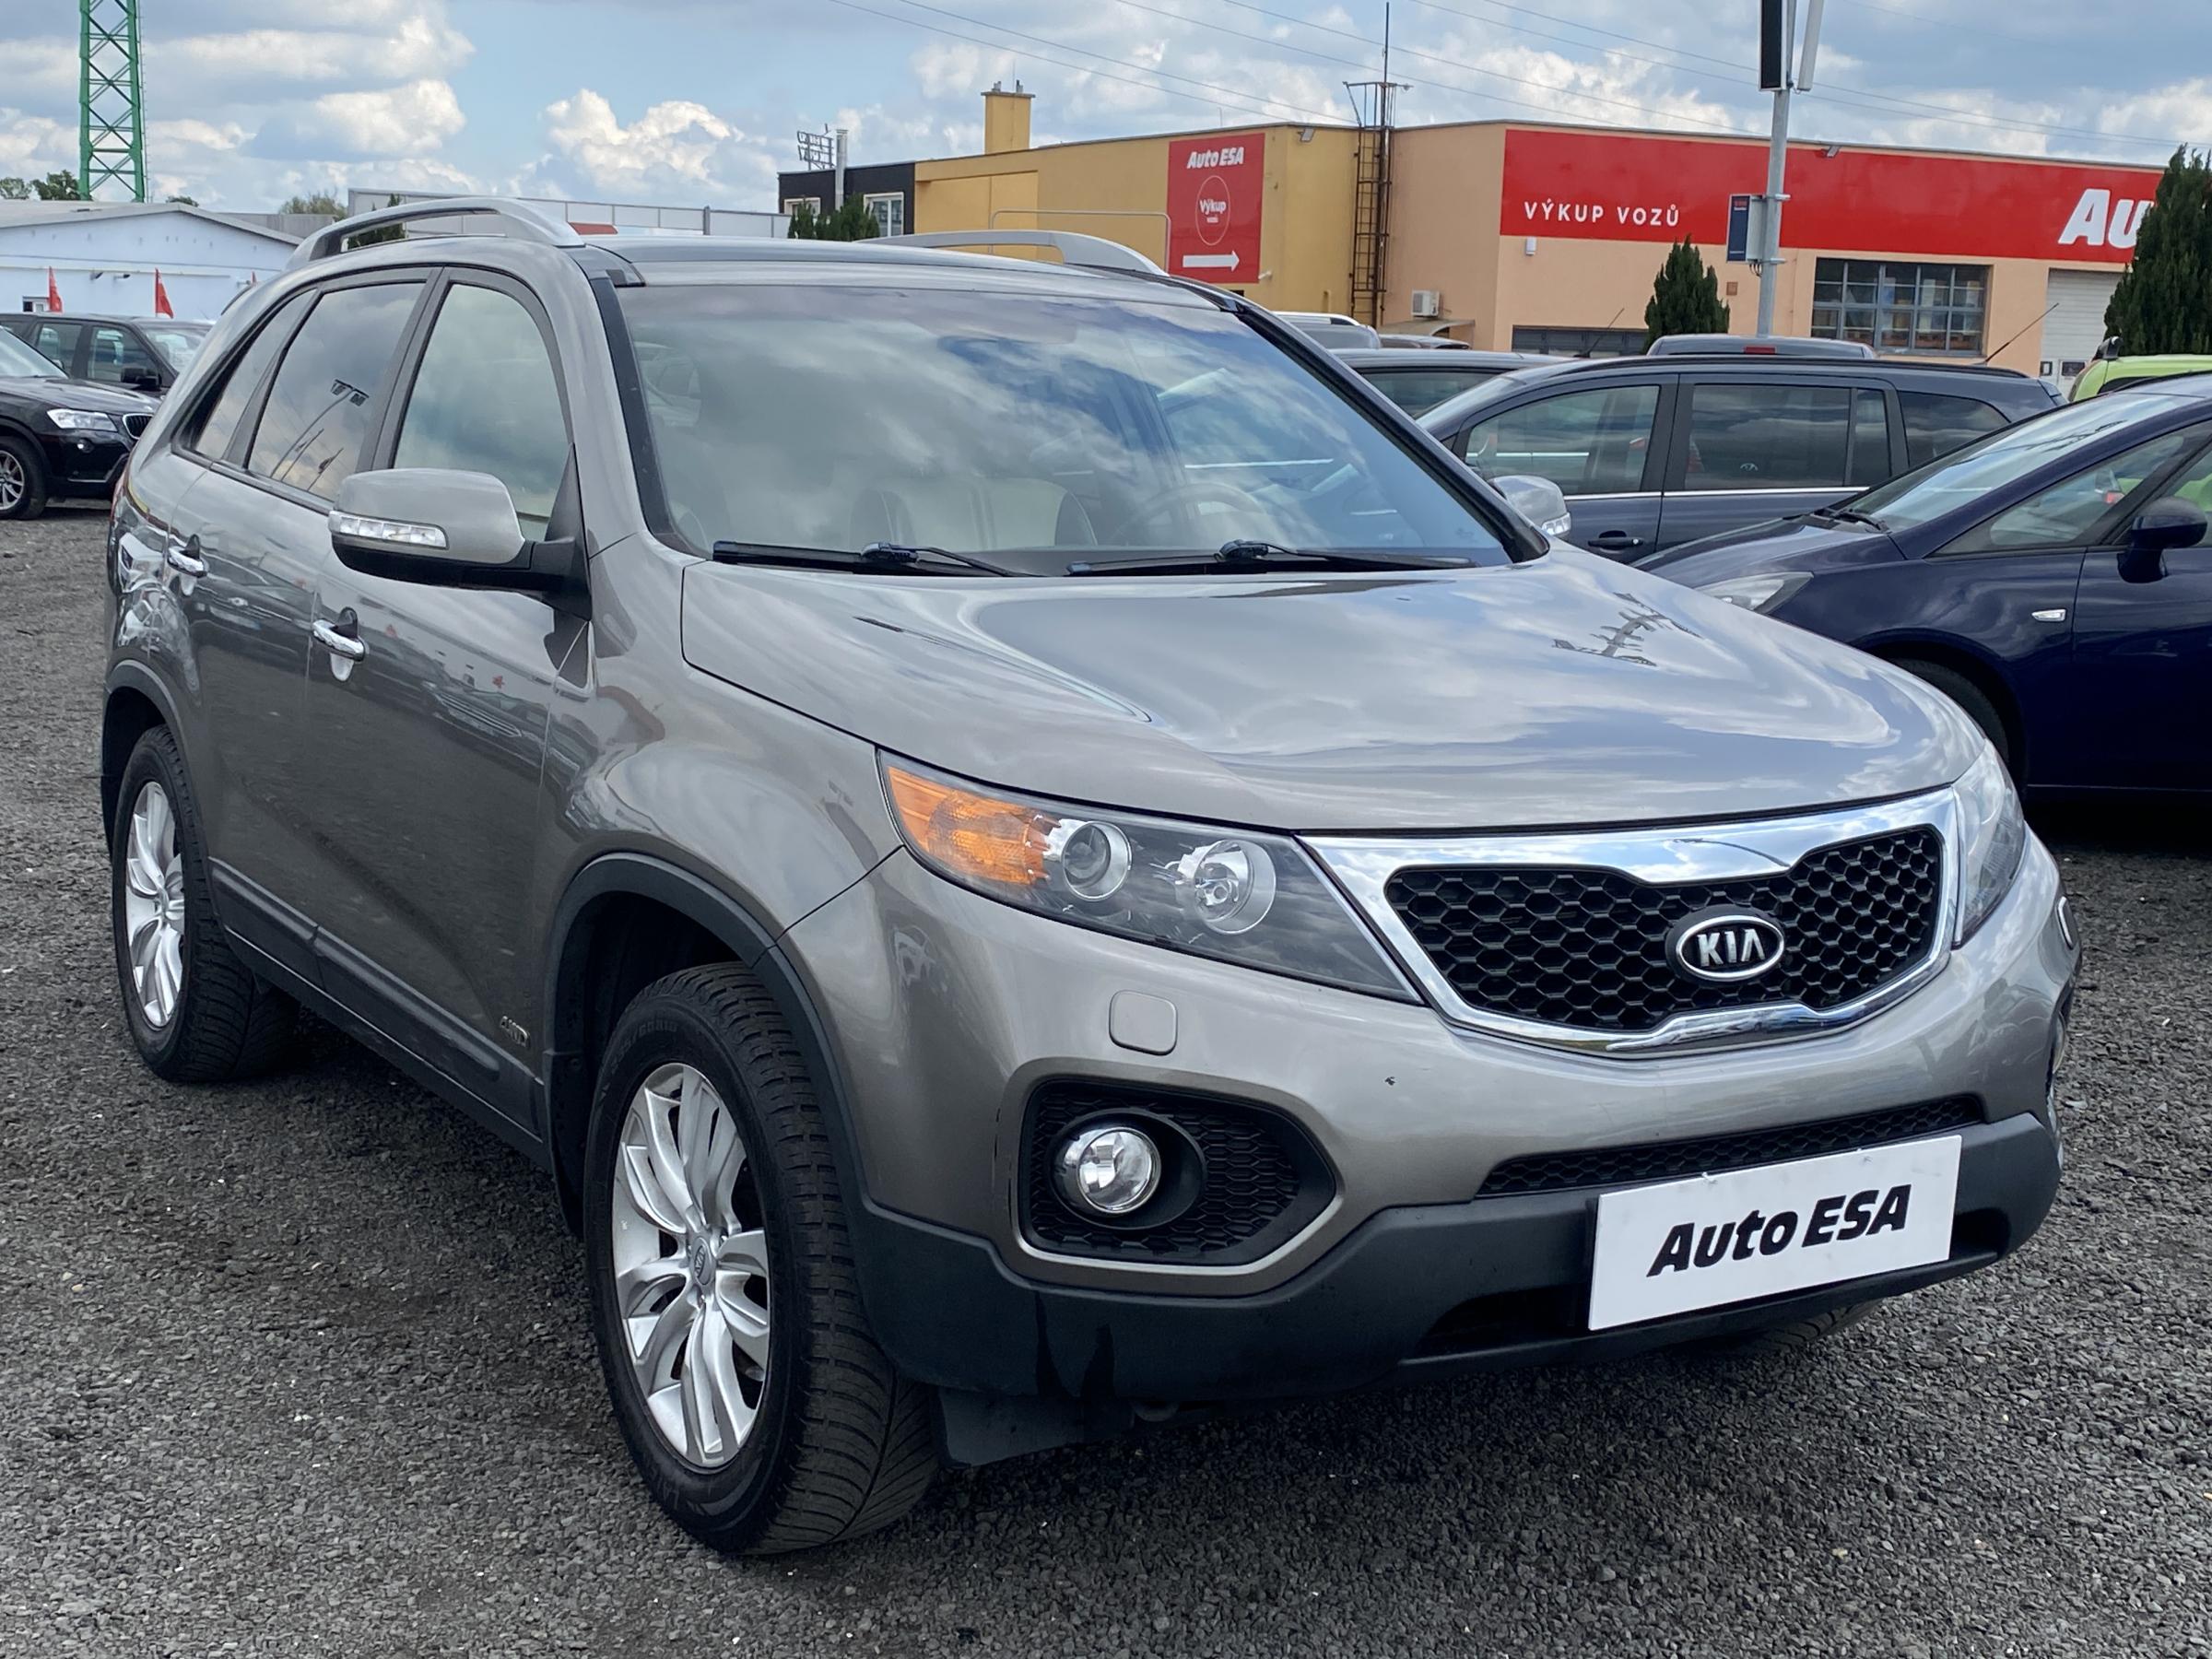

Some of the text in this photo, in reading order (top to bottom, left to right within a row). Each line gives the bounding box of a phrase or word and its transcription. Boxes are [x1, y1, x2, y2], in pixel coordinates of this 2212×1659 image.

[1186, 147, 1244, 169] Auto ESA
[1199, 198, 1227, 215] Výkup
[1524, 197, 1679, 227] VÝKUP VOZŮ
[1697, 928, 1766, 967] KIA
[1645, 1183, 1912, 1277] Auto ESA
